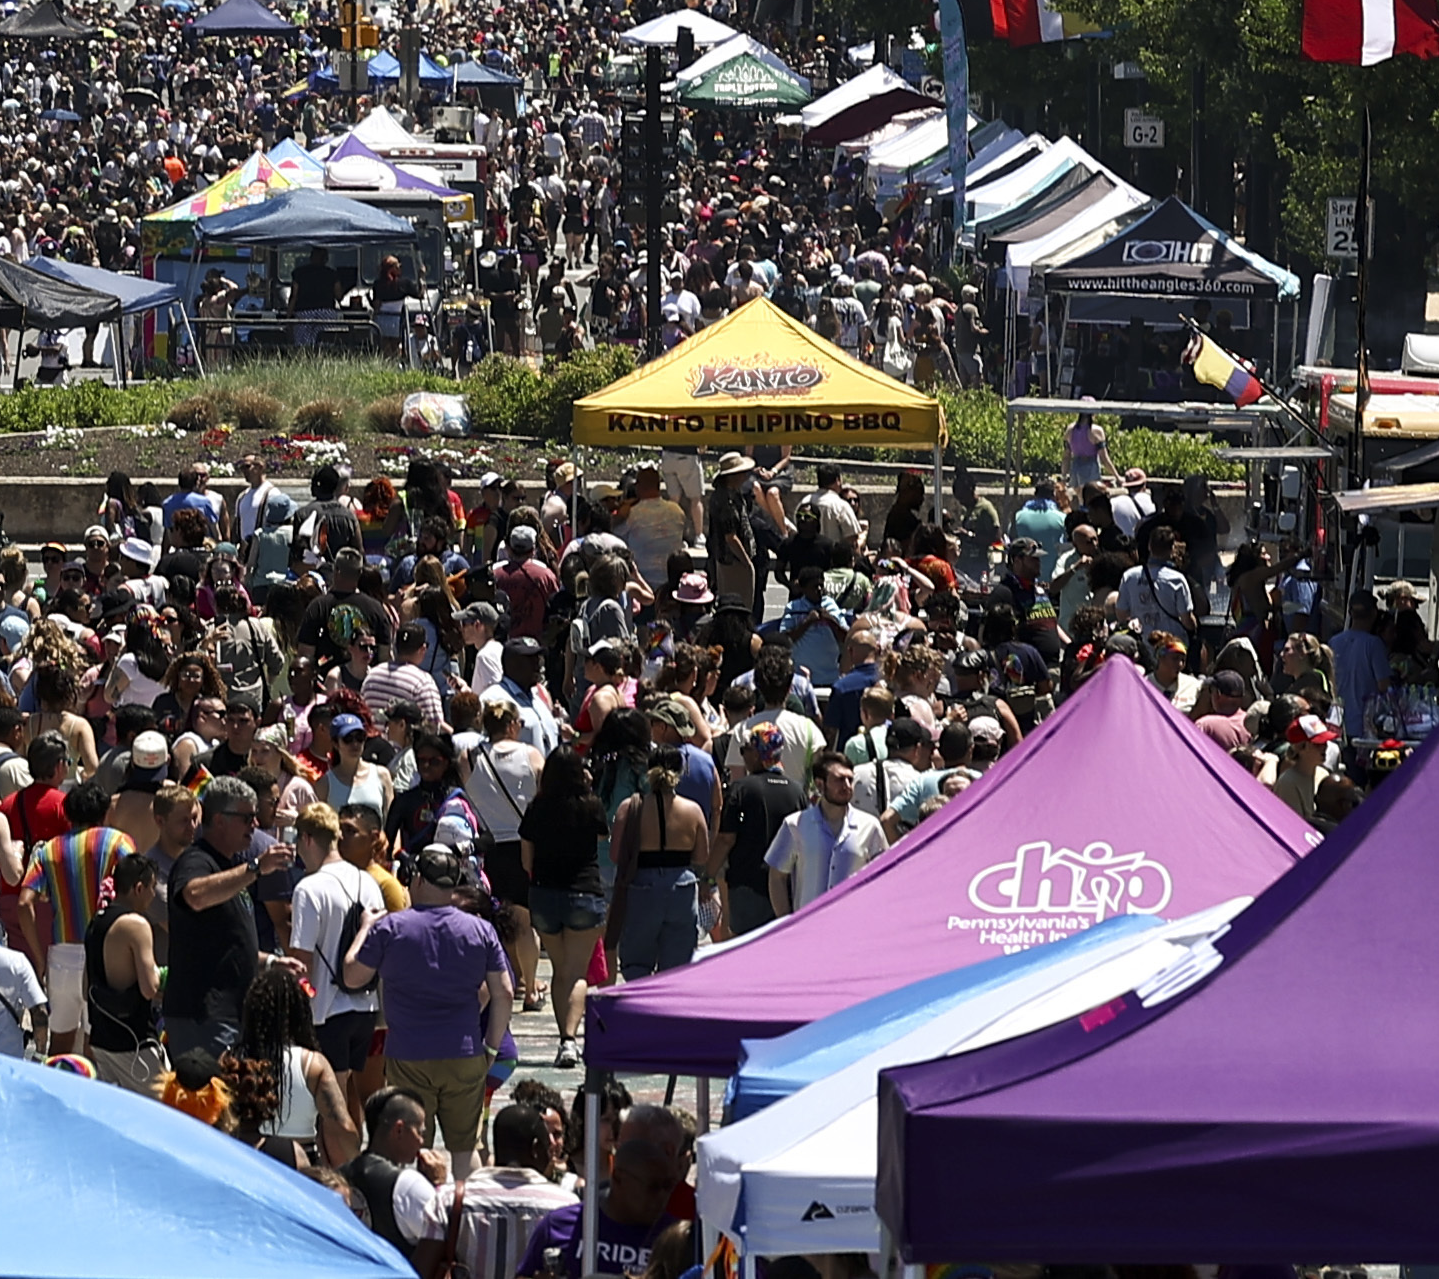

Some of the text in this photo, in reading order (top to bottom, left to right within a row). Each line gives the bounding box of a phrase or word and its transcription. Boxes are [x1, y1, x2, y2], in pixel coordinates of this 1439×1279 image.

[1132, 125, 1158, 144] G-2
[1173, 242, 1214, 263] HIT
[1067, 277, 1256, 294] www.hittheangles360.com
[692, 364, 824, 399] KANTO
[608, 410, 902, 433] KANTO FILIPINO BBQ
[969, 841, 1173, 924] chip
[947, 915, 1090, 933] Pennsylvania's
[979, 929, 1042, 946] Health
